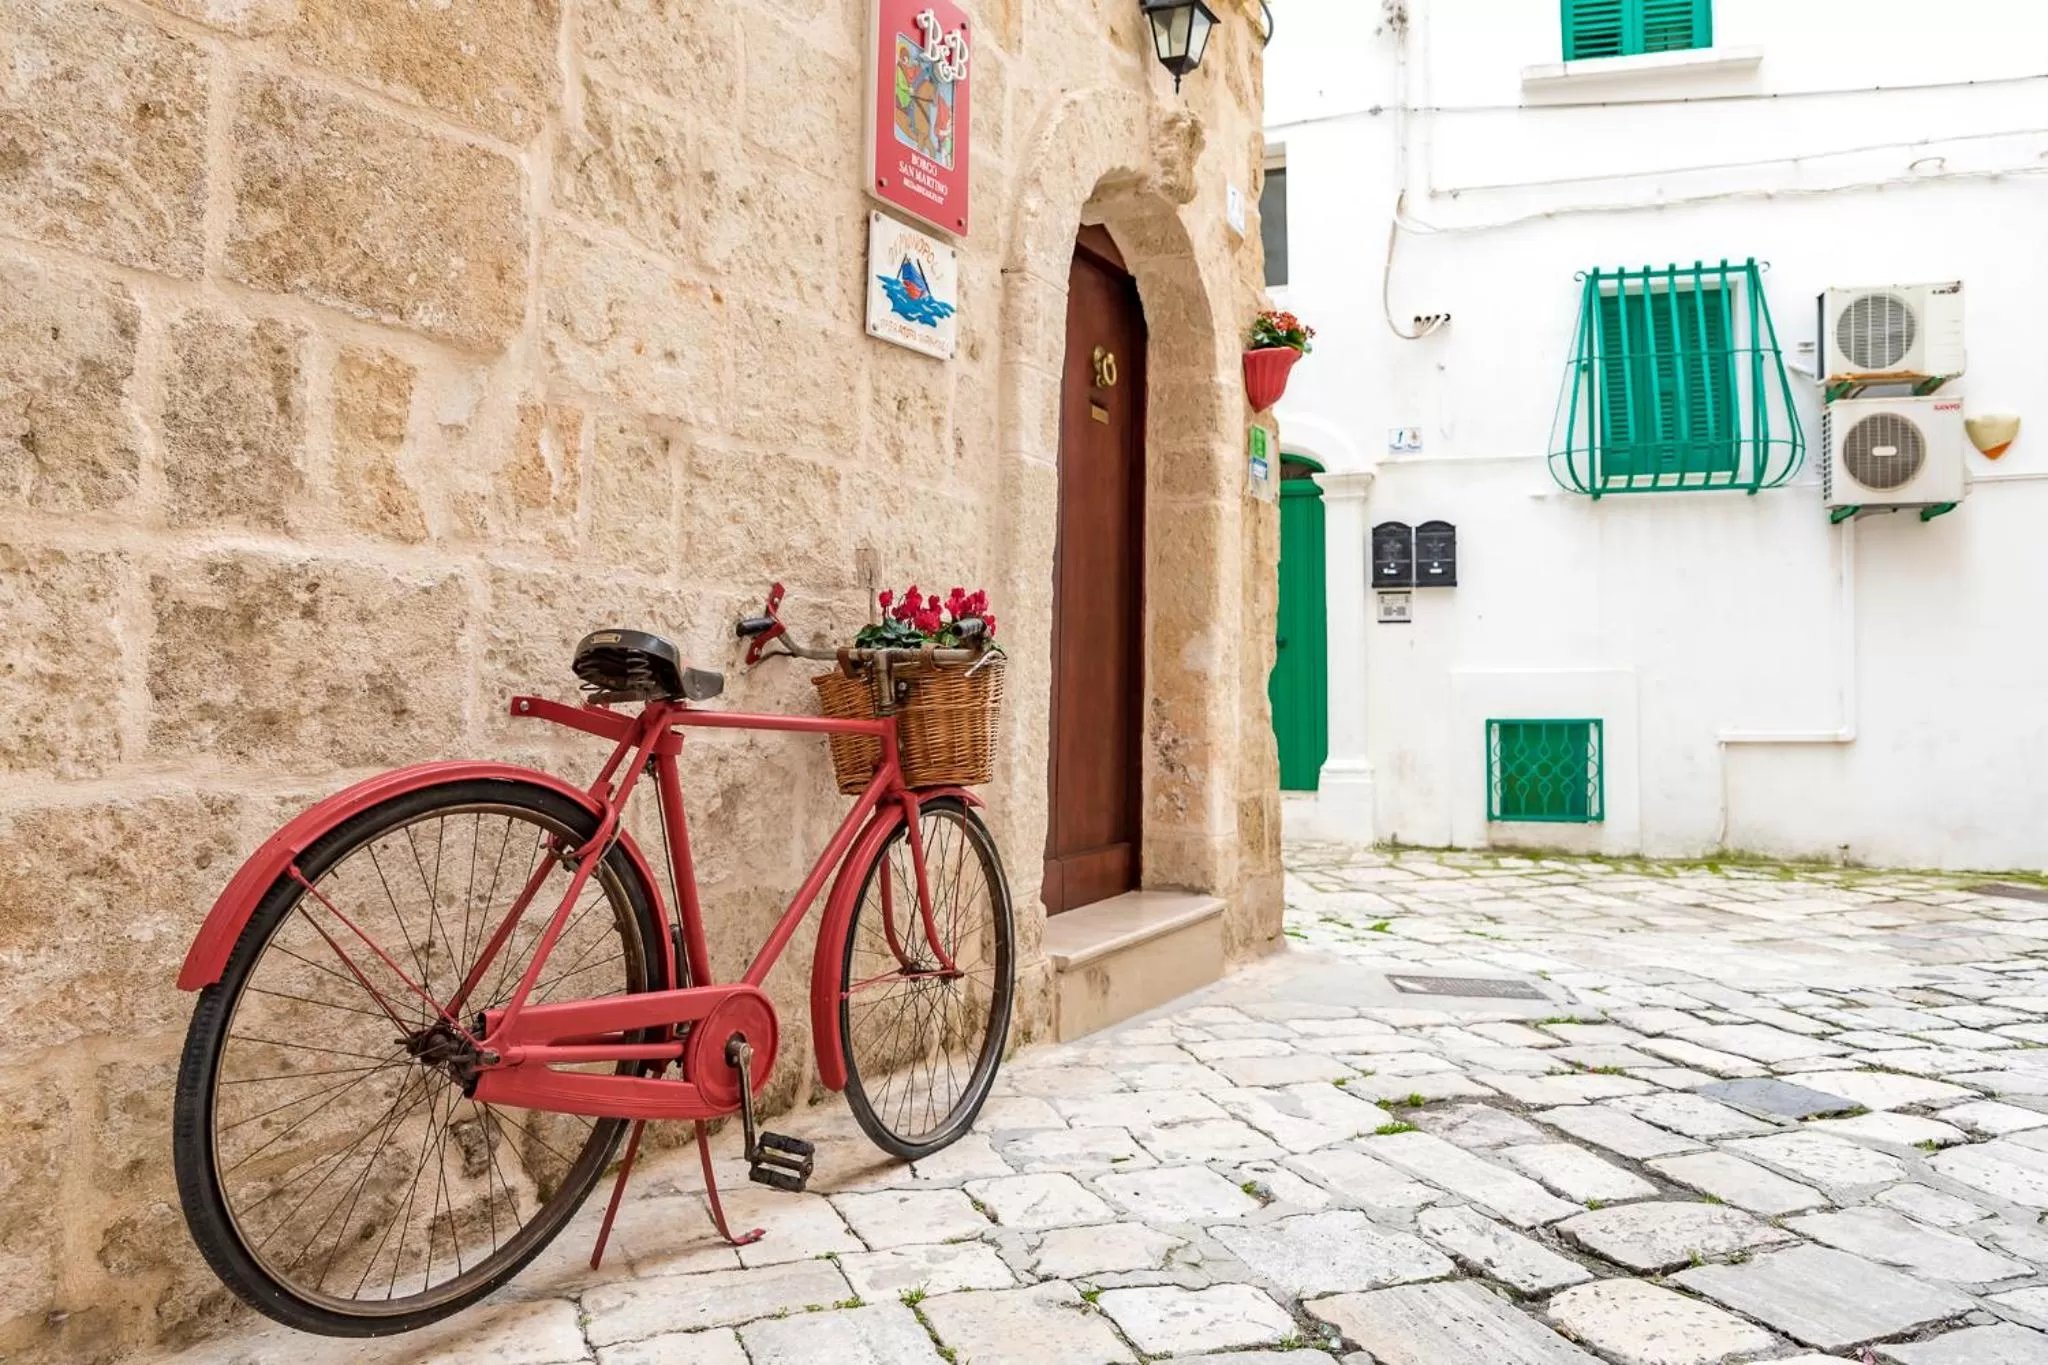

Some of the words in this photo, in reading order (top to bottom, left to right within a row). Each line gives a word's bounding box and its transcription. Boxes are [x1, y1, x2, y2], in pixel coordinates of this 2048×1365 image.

[916, 8, 969, 84] B&B
[898, 160, 914, 178] SAN
[915, 169, 948, 197] MARTINO
[911, 152, 939, 177] BORGO
